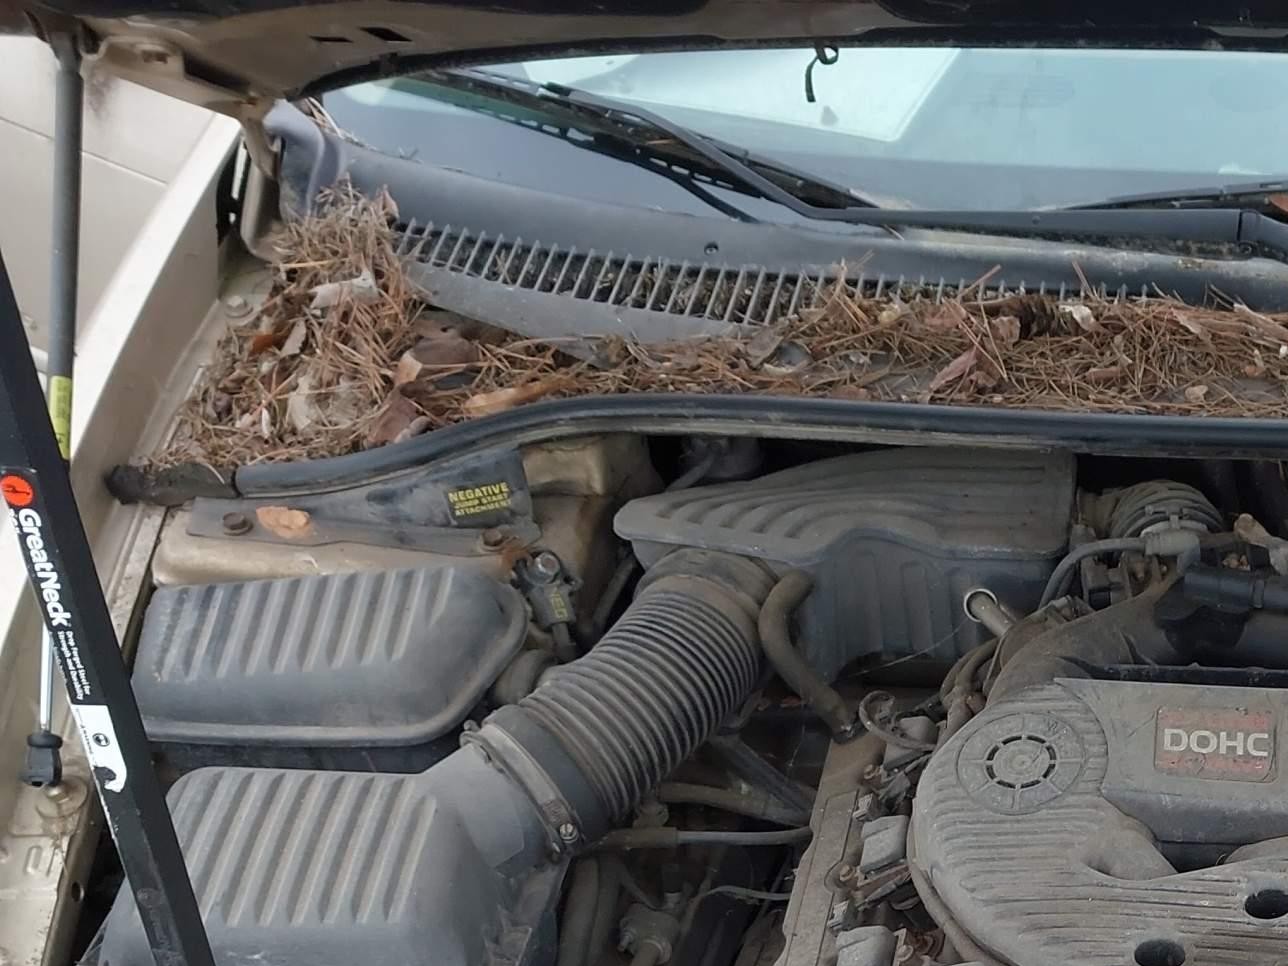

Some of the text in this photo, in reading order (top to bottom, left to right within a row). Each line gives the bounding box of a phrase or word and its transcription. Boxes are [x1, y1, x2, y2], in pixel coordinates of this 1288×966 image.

[448, 482, 509, 503] NEGATIVE
[481, 493, 508, 504] START
[19, 508, 71, 627] GreatNeck
[1163, 728, 1269, 757] DOHC
